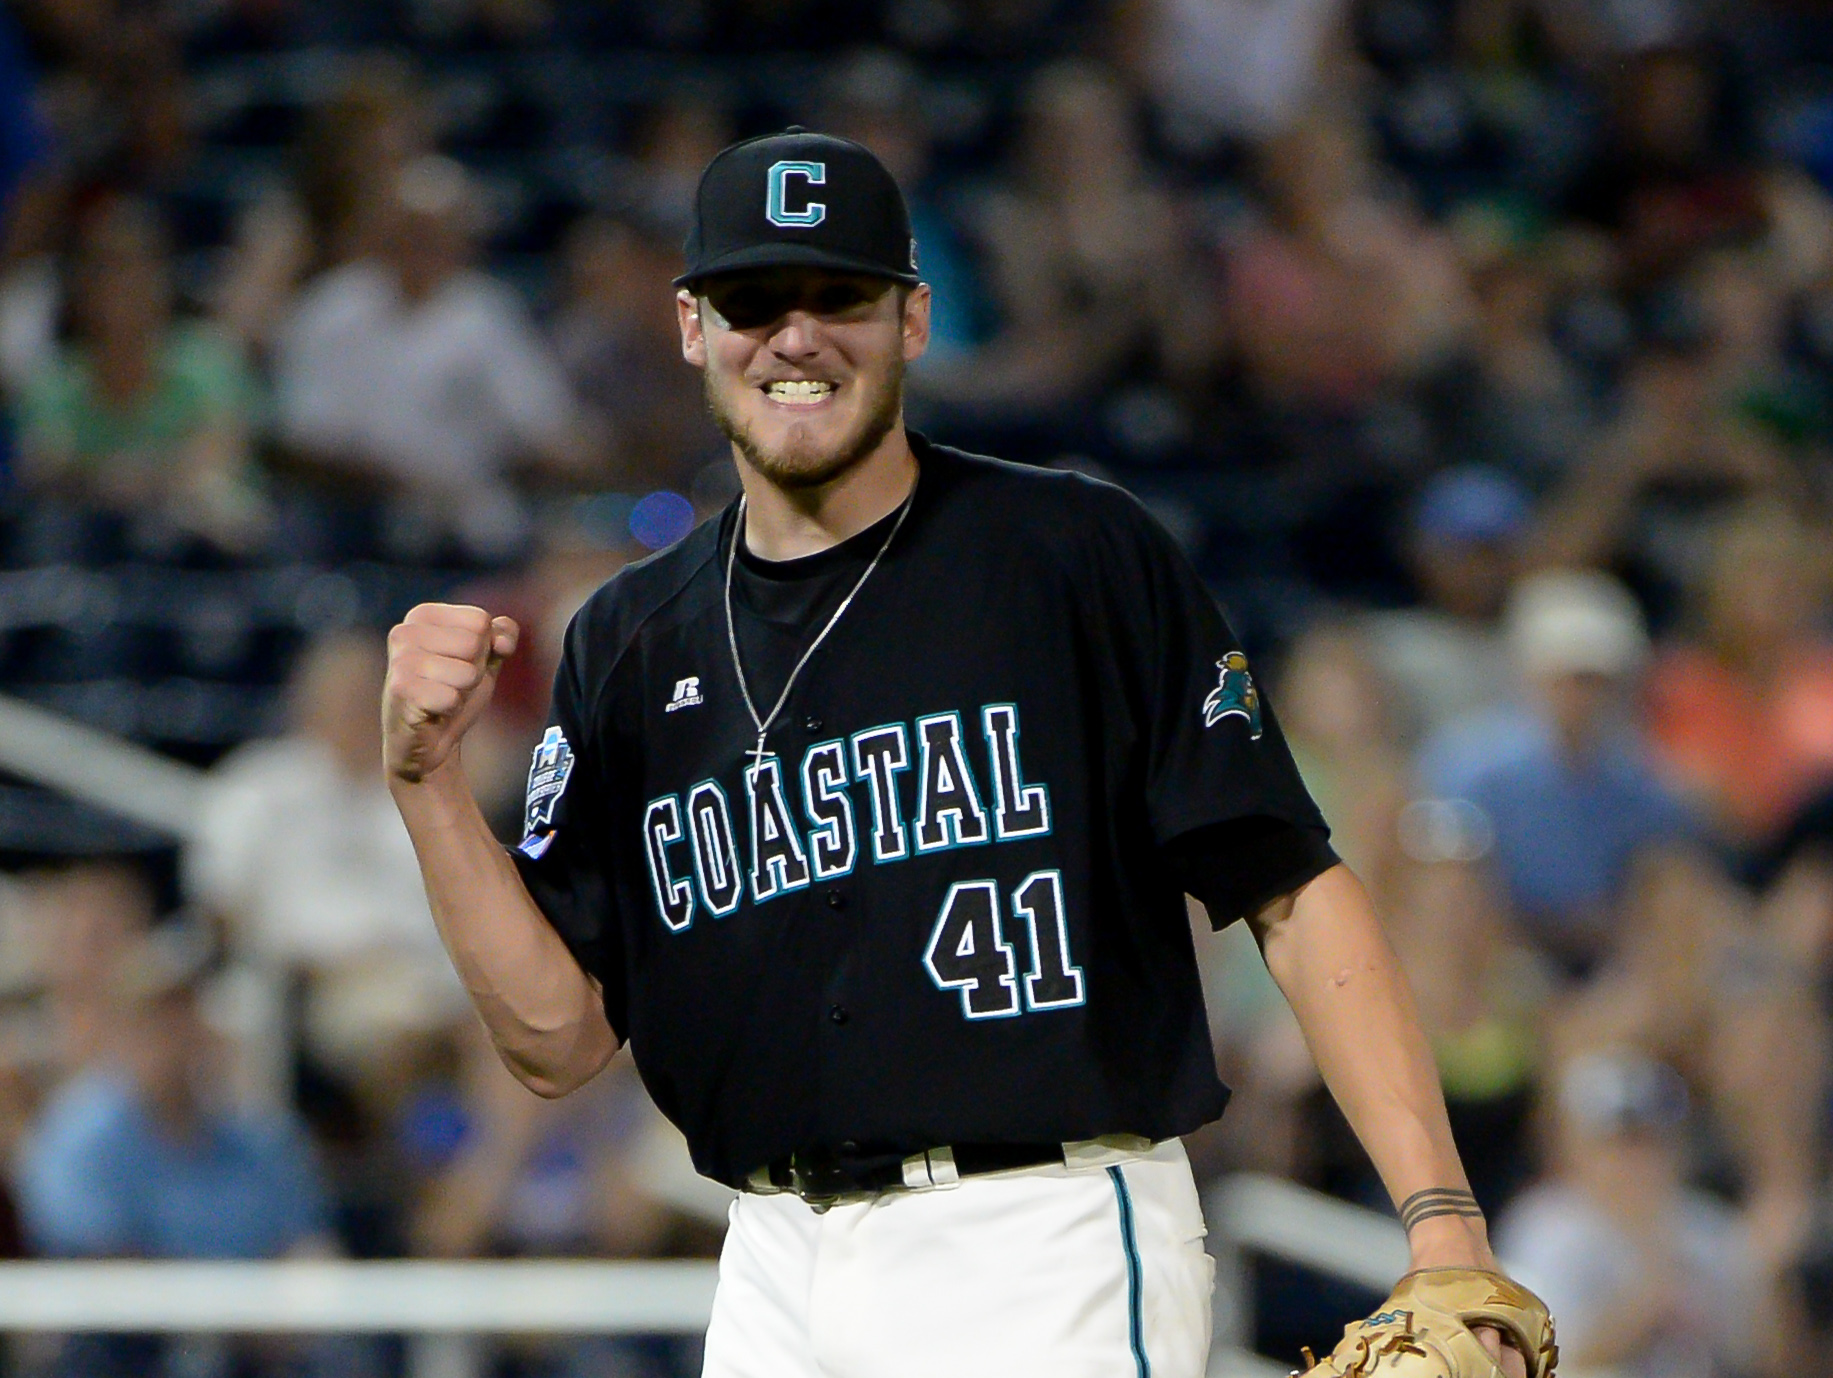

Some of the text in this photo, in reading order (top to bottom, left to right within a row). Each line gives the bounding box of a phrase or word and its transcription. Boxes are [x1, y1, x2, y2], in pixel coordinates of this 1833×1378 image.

[765, 160, 826, 227] C
[643, 703, 1050, 933] COASTAL
[924, 869, 1085, 1020] 41
